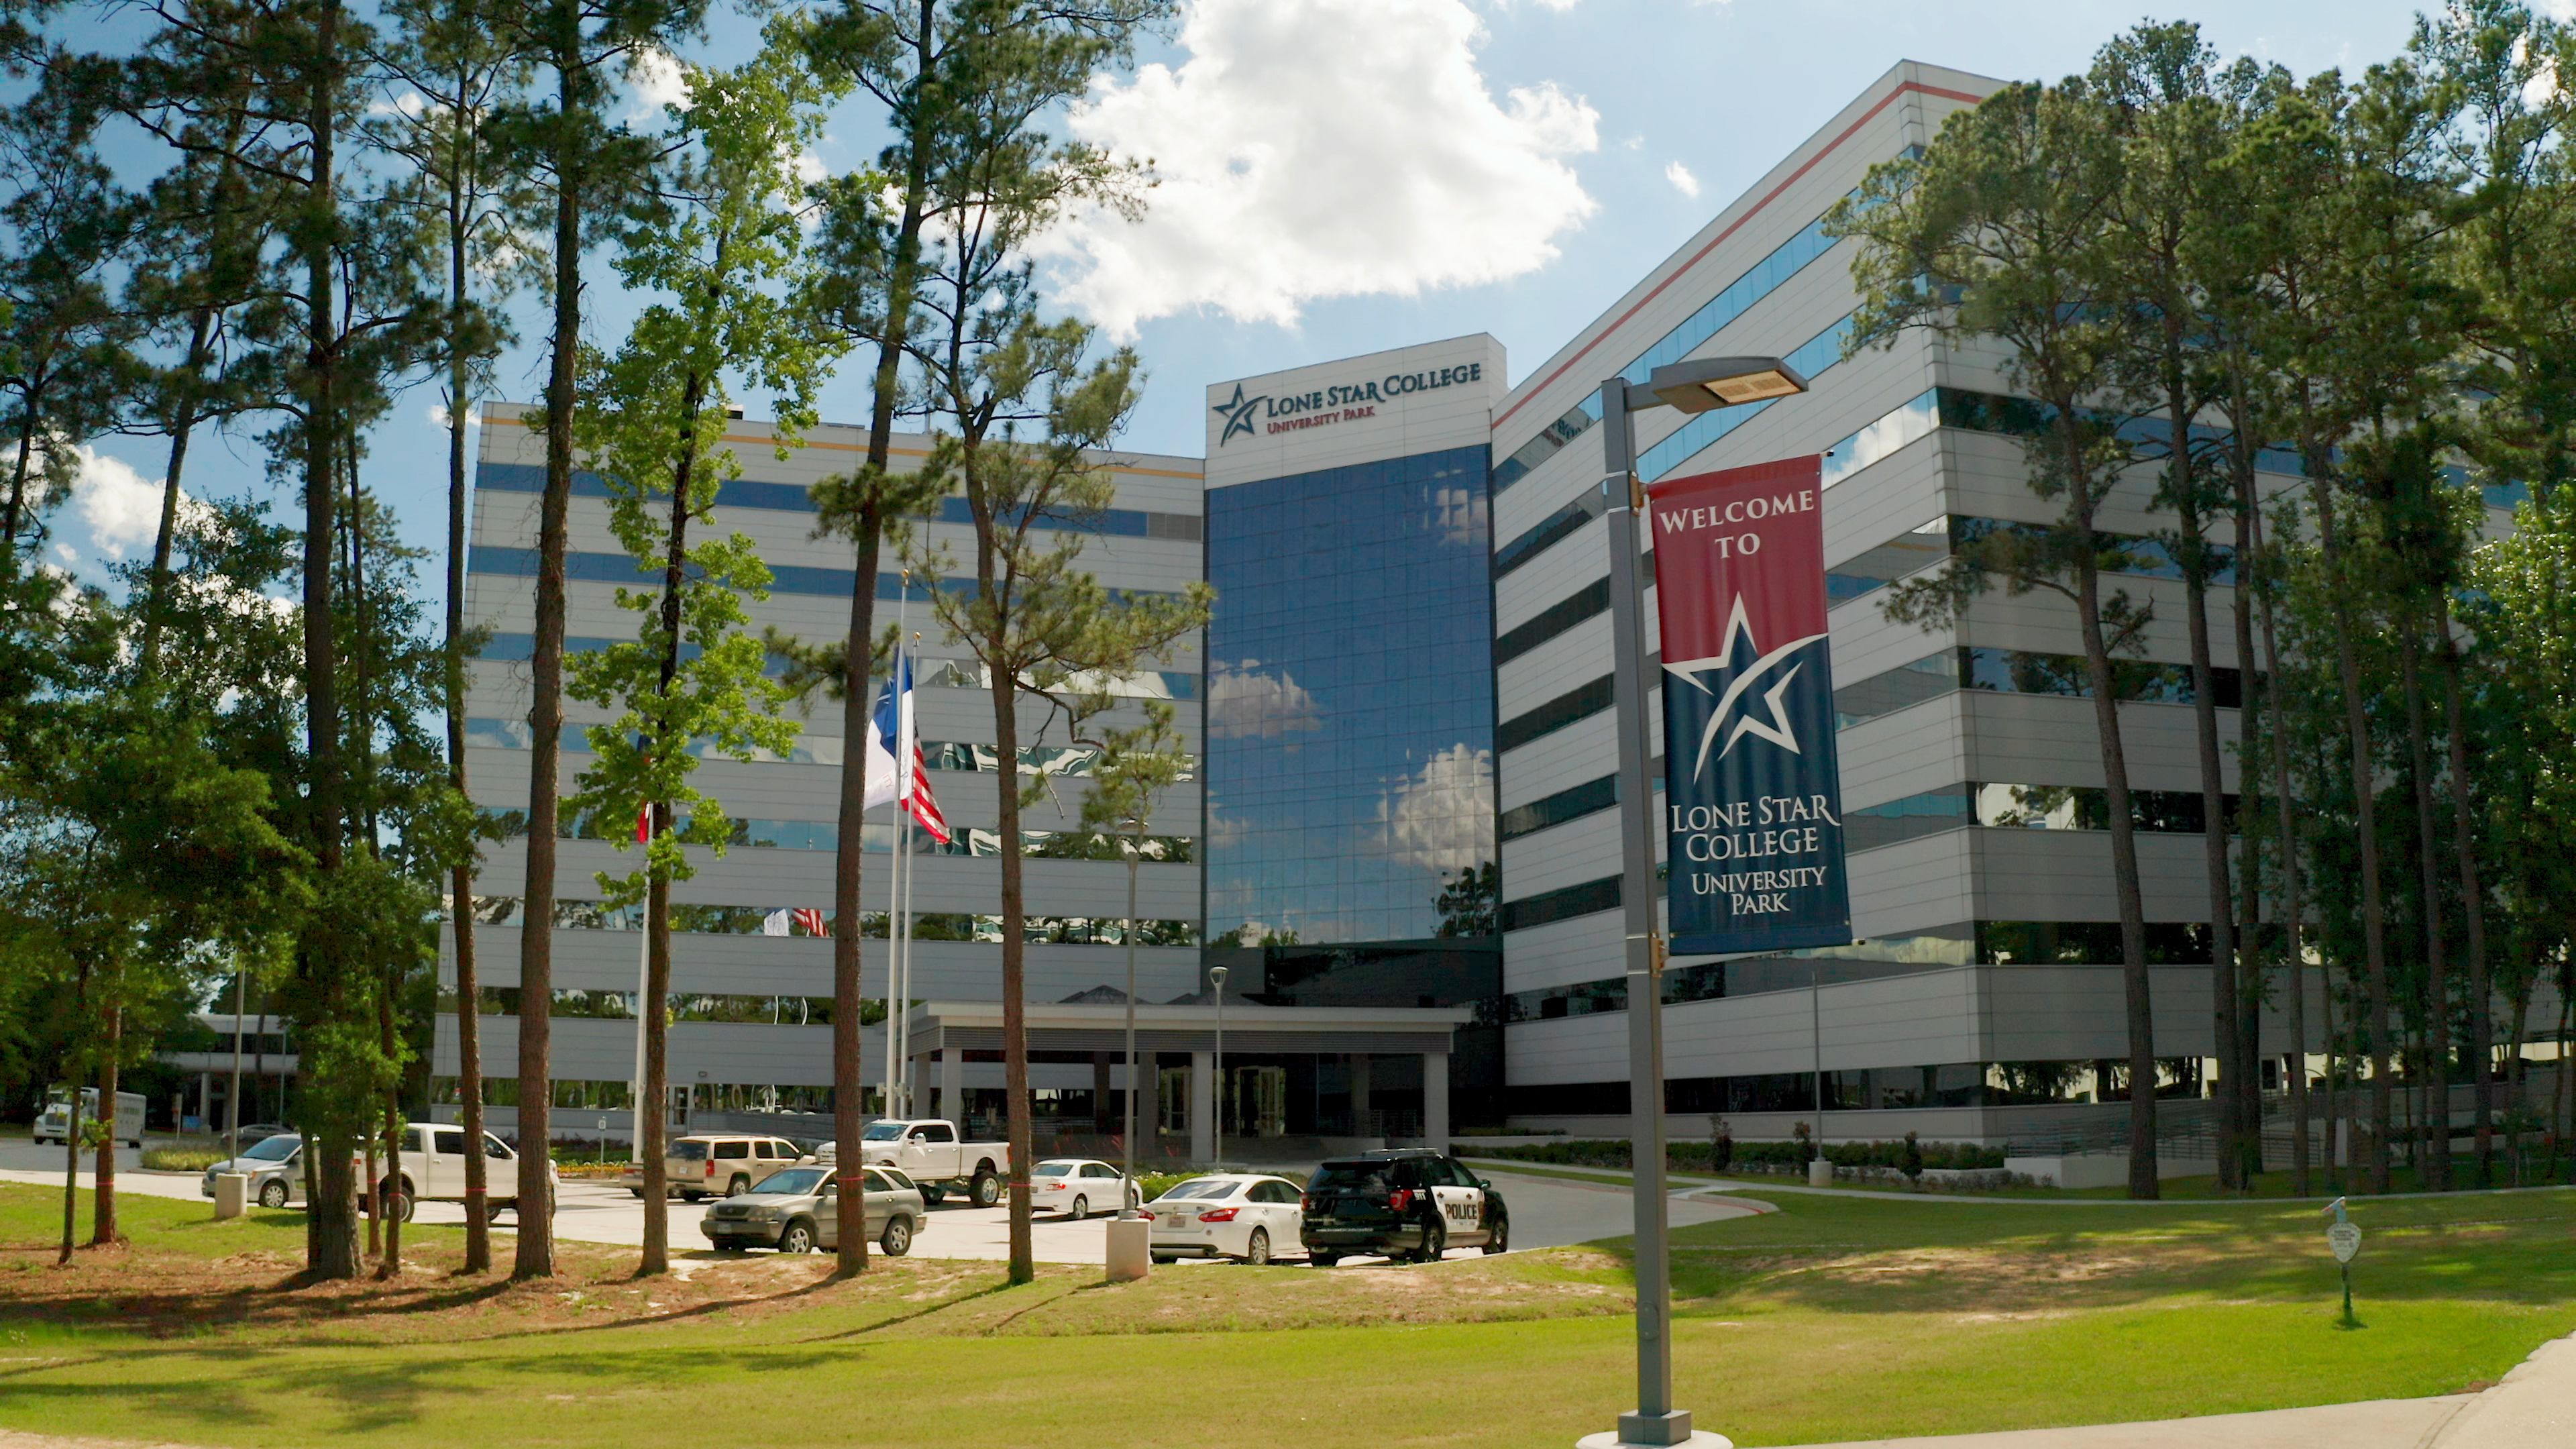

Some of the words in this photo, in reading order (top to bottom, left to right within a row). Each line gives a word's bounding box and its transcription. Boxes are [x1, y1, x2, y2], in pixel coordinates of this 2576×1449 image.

[1267, 392, 1322, 419] LONE
[1328, 382, 1386, 407] STAR
[1383, 363, 1481, 396] COLLEGE
[1267, 411, 1340, 435] UNIVERSITY
[1344, 406, 1376, 421] PARK
[1659, 490, 1815, 535] WELCOME
[1715, 533, 1761, 559] TO
[1672, 802, 1751, 833] LONE
[1759, 794, 1841, 826] STAR
[1686, 827, 1819, 862] COLLEGE
[1691, 866, 1827, 895] UNIVERSITY
[1731, 893, 1790, 916] PARK
[1414, 1192, 1427, 1201] 911
[1445, 1203, 1477, 1220] POLICE
